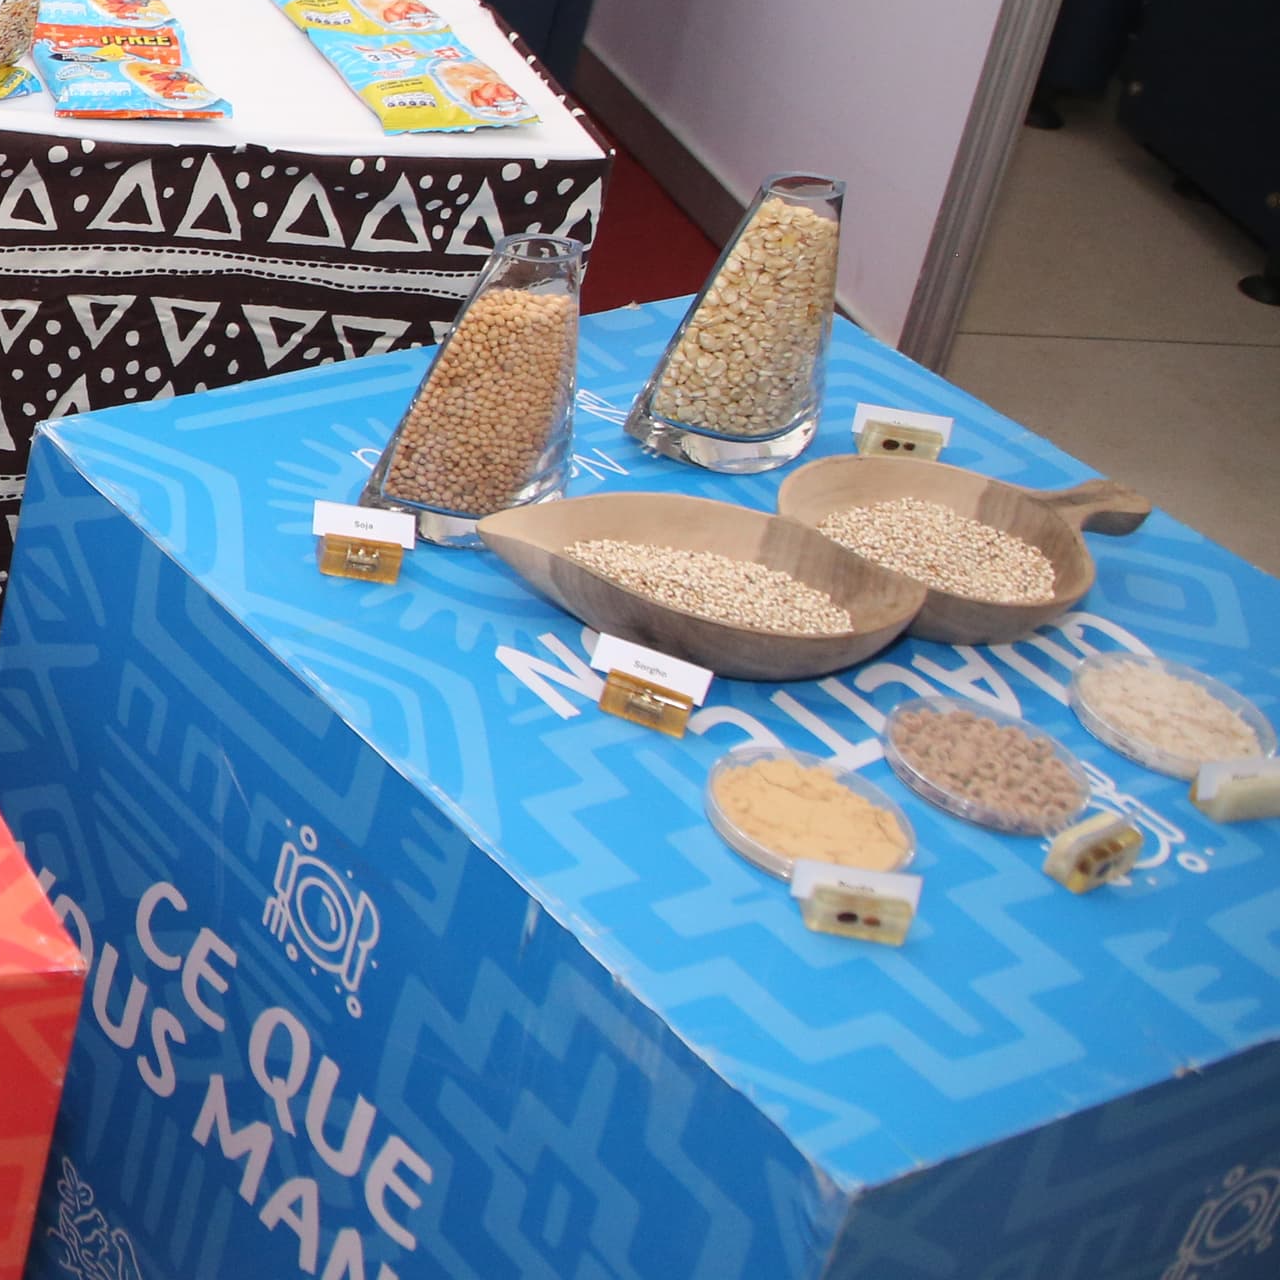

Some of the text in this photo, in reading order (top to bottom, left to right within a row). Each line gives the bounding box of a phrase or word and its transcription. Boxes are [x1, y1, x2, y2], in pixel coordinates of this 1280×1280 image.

[633, 659, 668, 679] Sorgho
[135, 880, 434, 1253] CE QUE
